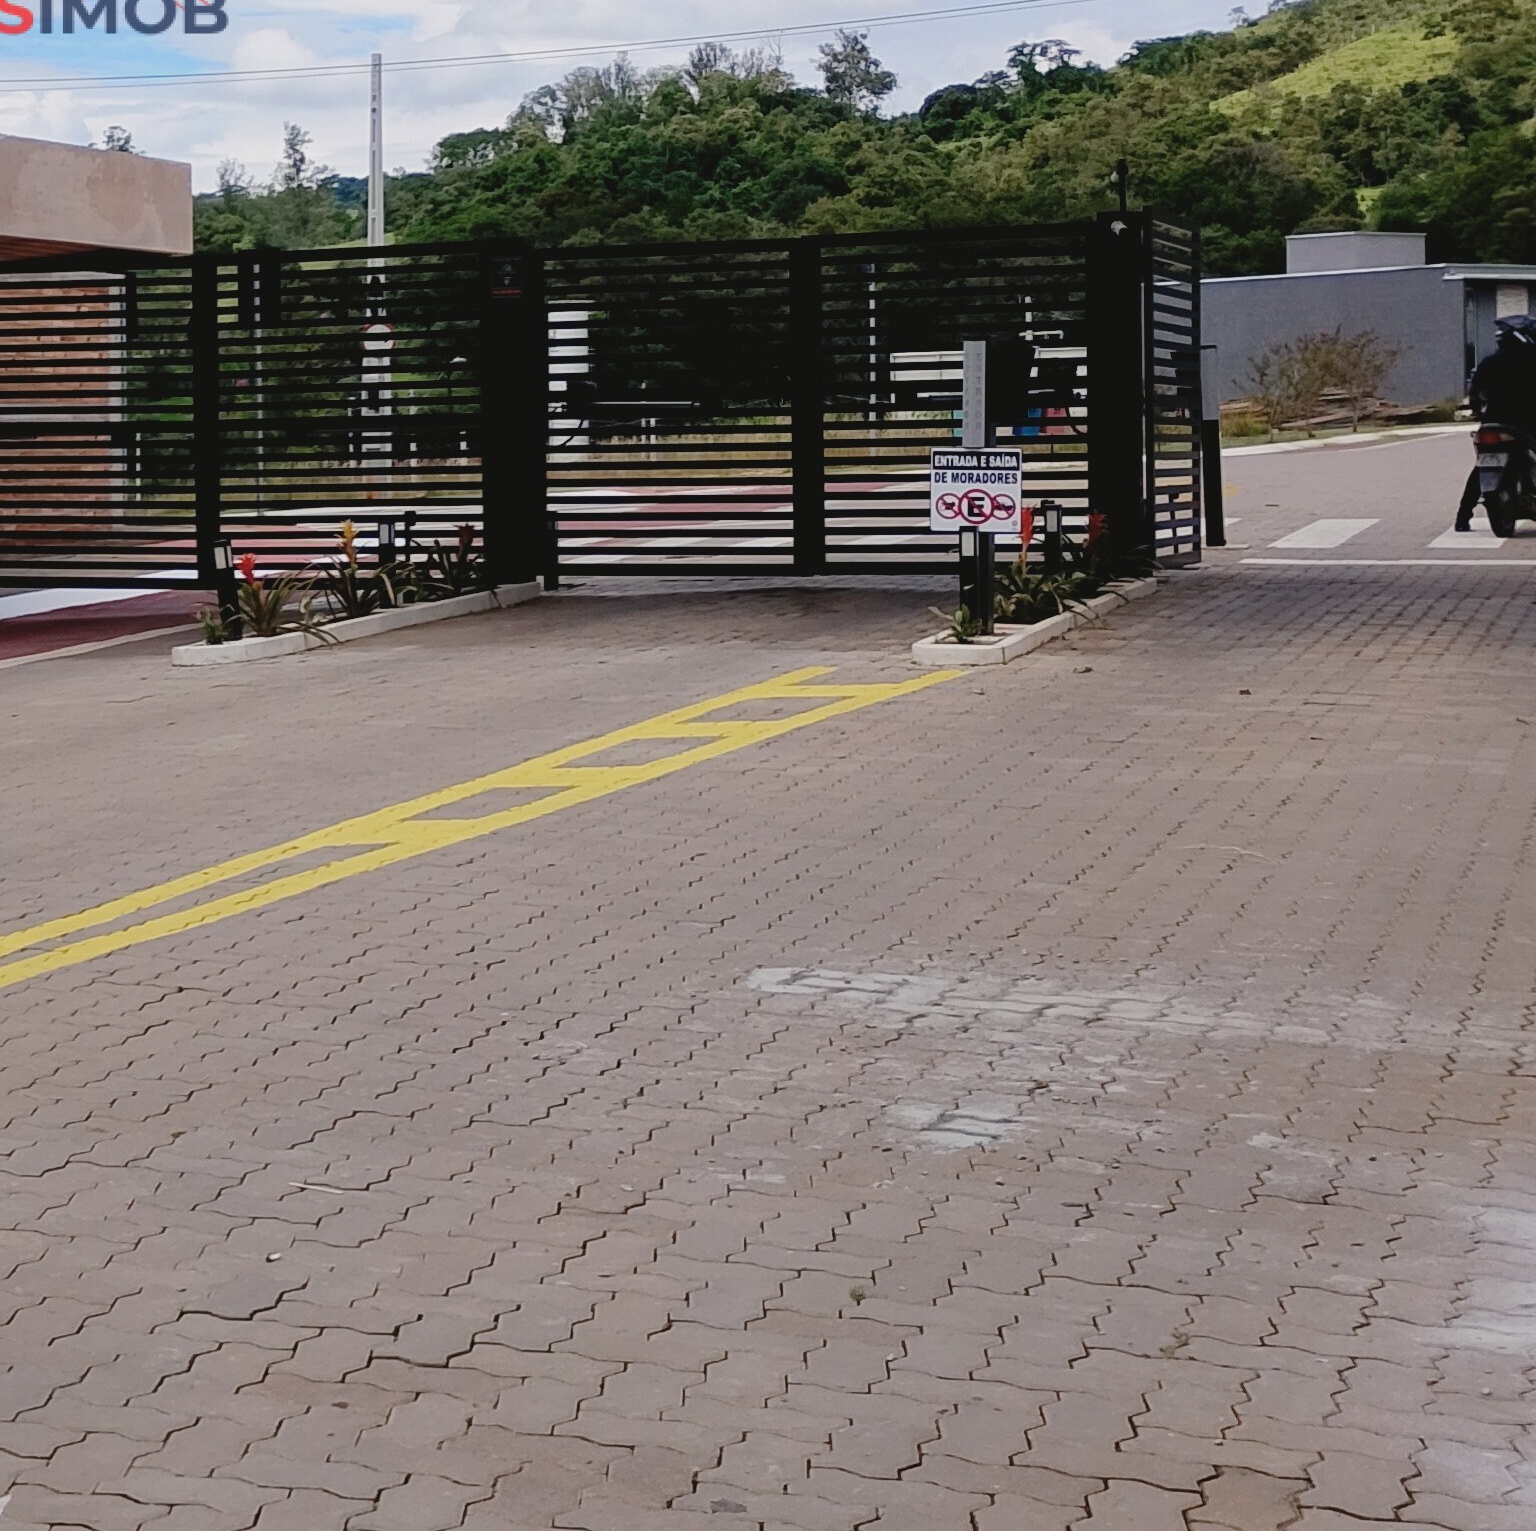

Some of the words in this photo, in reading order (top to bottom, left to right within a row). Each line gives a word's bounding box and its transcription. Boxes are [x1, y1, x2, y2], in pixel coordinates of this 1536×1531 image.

[934, 455, 978, 467] ENTRADA
[980, 455, 987, 467] E
[989, 454, 1018, 467] SAÍDA
[934, 472, 948, 483] DE
[951, 472, 1018, 484] MORADORES
